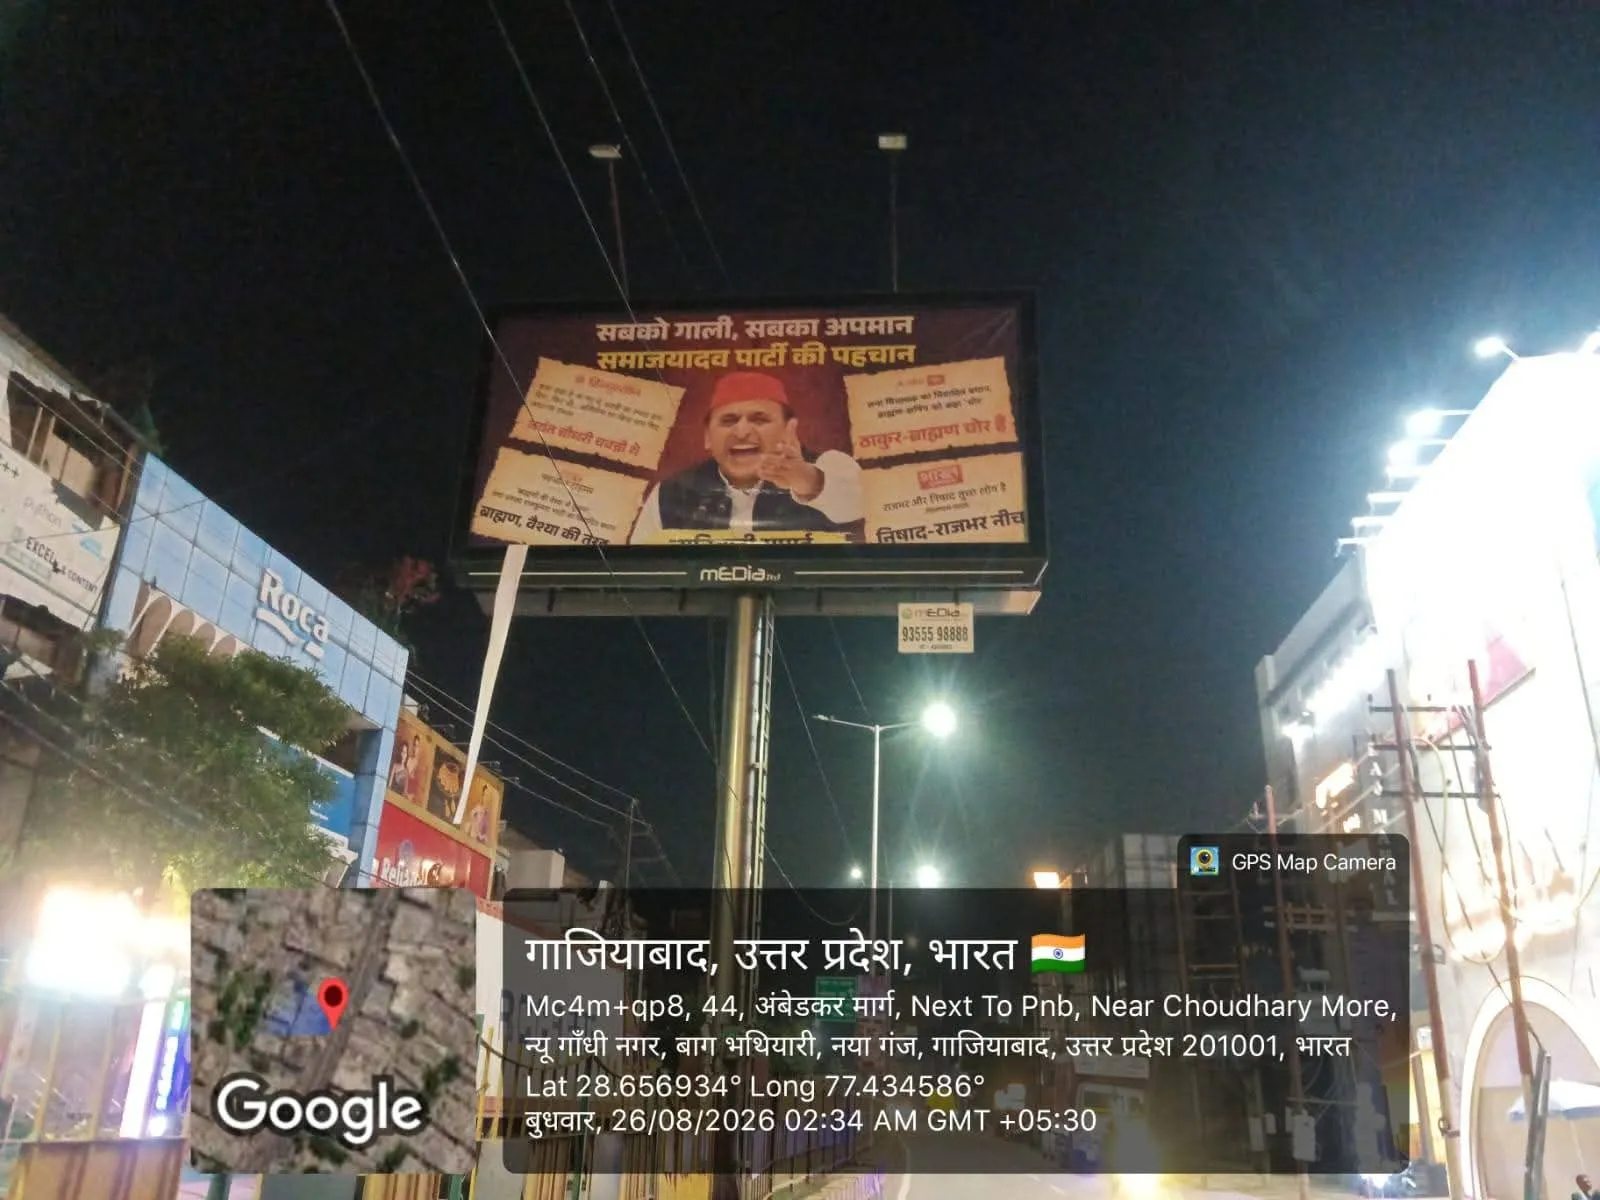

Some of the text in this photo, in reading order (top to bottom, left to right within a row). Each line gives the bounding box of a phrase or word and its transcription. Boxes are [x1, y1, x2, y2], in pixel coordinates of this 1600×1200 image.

[596, 315, 914, 341] सबको गाली, सबका अपमान
[597, 341, 916, 370] समाजयादव पार्टी की पहचान
[859, 412, 1008, 450] ठाकुर-ब्राह्मण चोर है
[480, 505, 522, 528] ब्राह्मण,
[526, 515, 561, 537] वैश्या
[561, 526, 581, 542] की
[876, 508, 1025, 544] निषाद-राजभर नीच
[260, 567, 330, 643] Roca
[902, 626, 968, 642] 93555 98888
